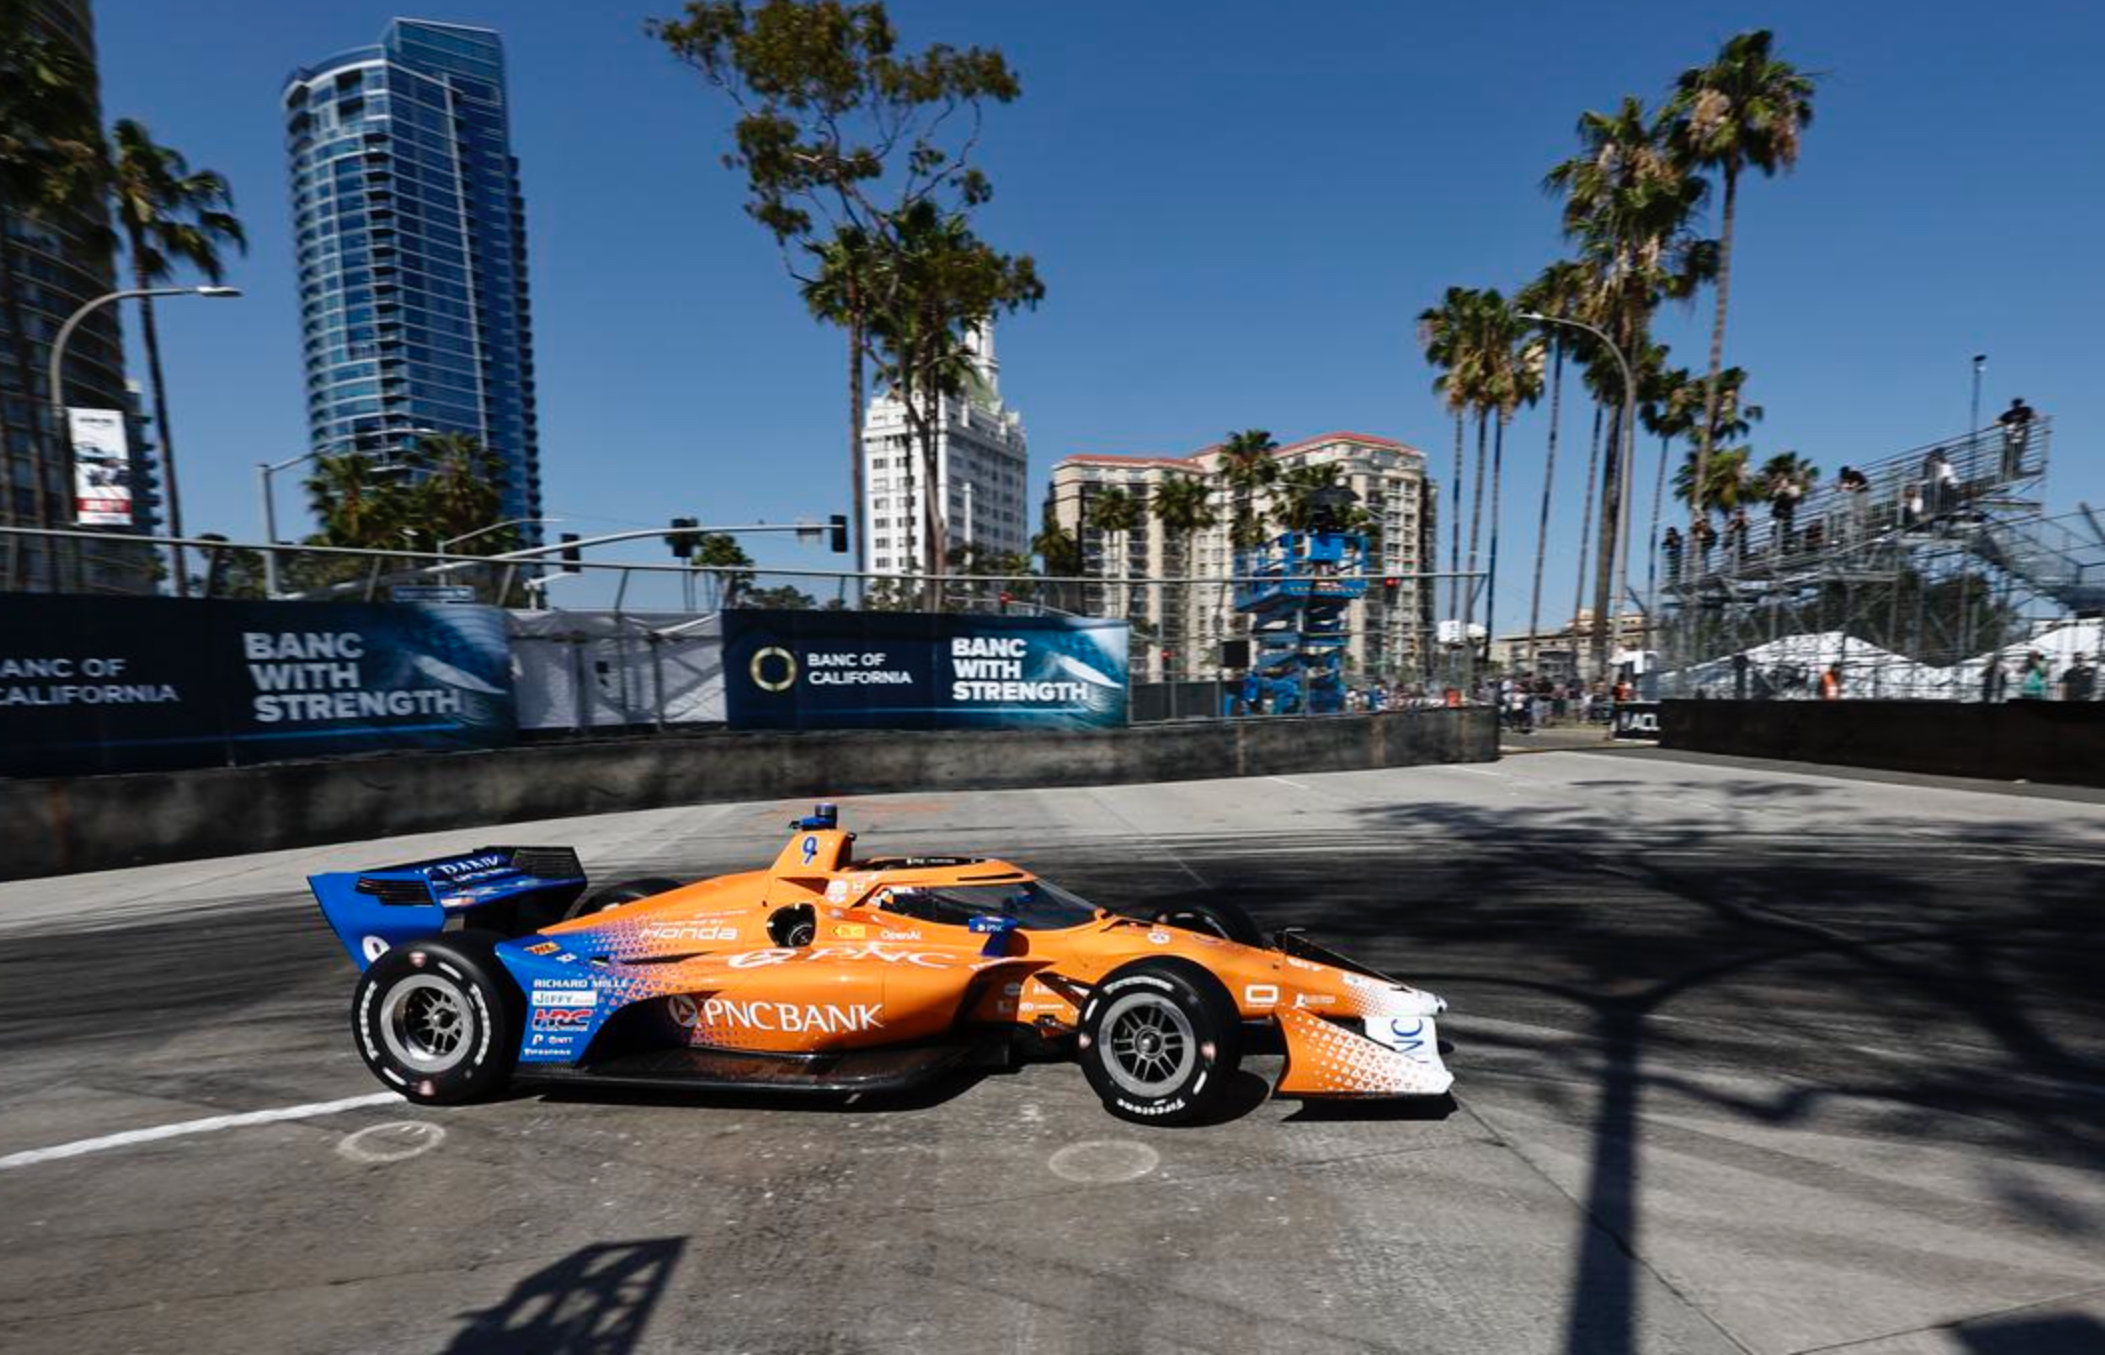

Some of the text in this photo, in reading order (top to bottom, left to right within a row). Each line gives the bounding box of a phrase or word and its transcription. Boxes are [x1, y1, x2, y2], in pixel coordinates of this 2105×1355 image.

[243, 632, 365, 660] BANC
[951, 637, 1028, 658] BANC
[0, 658, 127, 677] ANC OF
[807, 653, 887, 667] BANC OF
[952, 659, 1022, 680] WITH
[248, 662, 361, 691] WITH
[808, 671, 914, 685] CALIFORNIA
[0, 685, 182, 706] ALIFORNIA
[952, 681, 1089, 701] STRENGTH
[253, 688, 463, 722] STRENGTH
[803, 836, 817, 865] 9
[880, 930, 921, 940] OpenAI
[533, 978, 588, 988] RICHARD
[1391, 1018, 1429, 1063] NC
